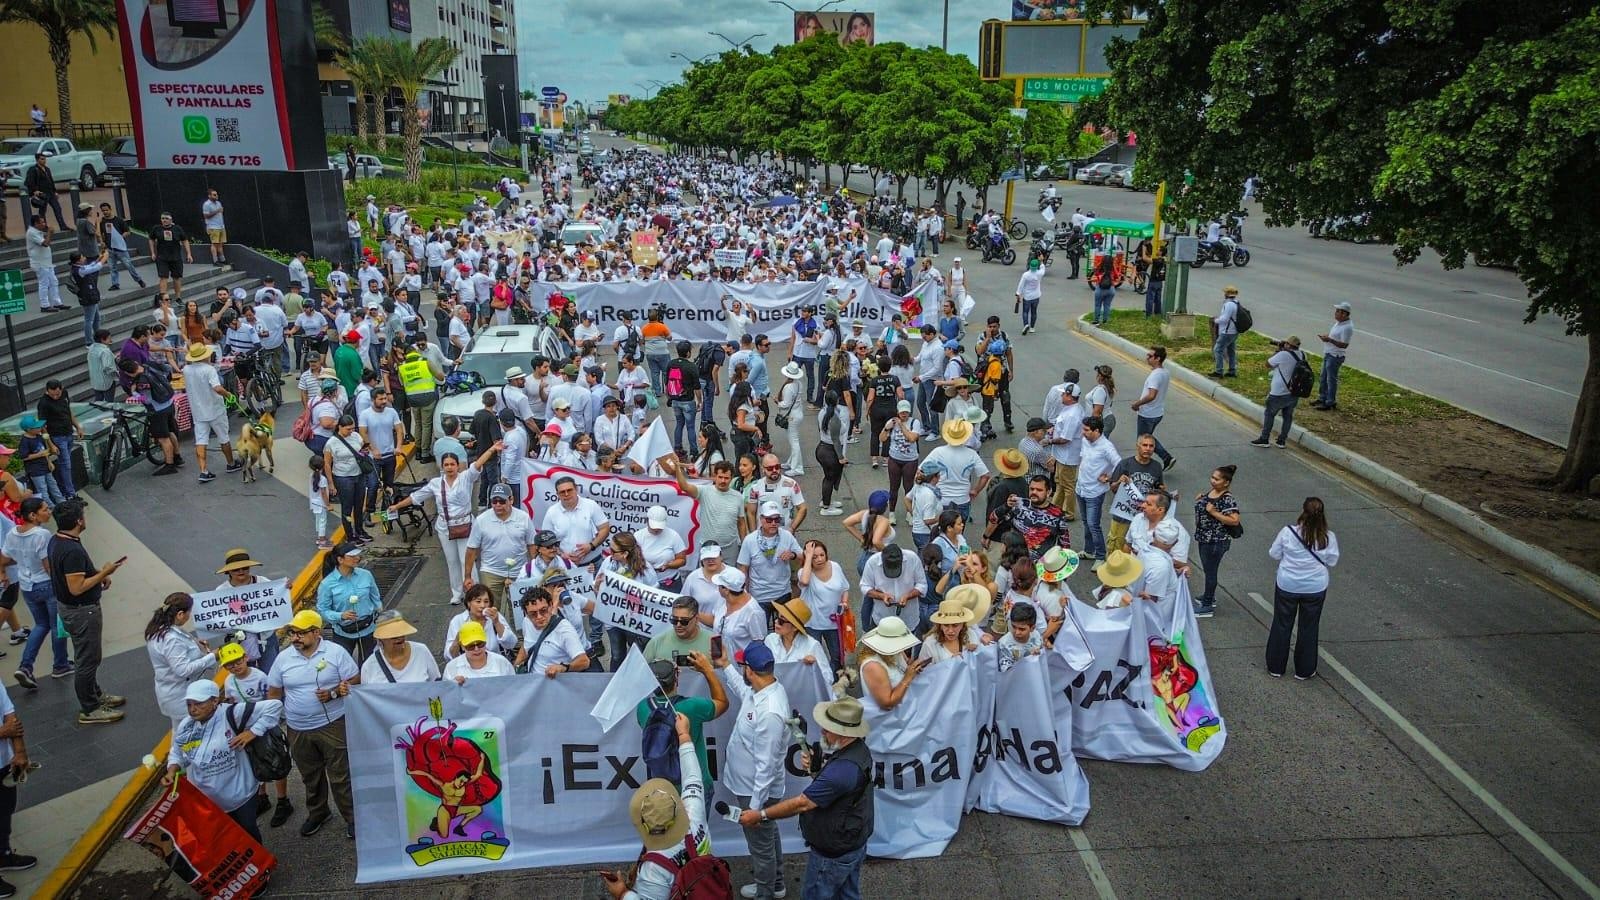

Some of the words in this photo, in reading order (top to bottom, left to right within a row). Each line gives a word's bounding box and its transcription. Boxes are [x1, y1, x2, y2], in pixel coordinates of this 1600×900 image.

[149, 84, 264, 95] ESPECTACULARES
[1027, 81, 1049, 90] LOS
[1054, 83, 1096, 92] MOCHIS
[165, 98, 173, 107] Y
[177, 98, 251, 108] PANTALLAS
[172, 155, 197, 165] 667
[201, 156, 226, 165] 746
[229, 156, 261, 166] 7126
[595, 305, 727, 325] ¡Recueremo
[838, 302, 885, 321] alles!
[589, 481, 660, 503] Culiacán
[592, 499, 618, 511] mor,
[573, 575, 583, 584] SE
[583, 585, 593, 593] LA
[605, 575, 658, 604] VALIENTE
[660, 595, 674, 608] ES
[200, 594, 239, 609] CULICHI
[240, 590, 260, 602] QUE
[262, 588, 274, 597] SE
[194, 606, 239, 622] RESPETA,
[240, 600, 272, 613] BUSCA
[274, 597, 287, 606] LA
[600, 592, 636, 612] QUIEN
[637, 604, 670, 623] ELIGE
[206, 620, 227, 632] PAZ
[228, 611, 280, 628] COMPLETA
[611, 612, 626, 626] LA
[628, 617, 654, 634] PAZ
[484, 731, 494, 739] 27
[432, 848, 488, 859] VALIENTE
